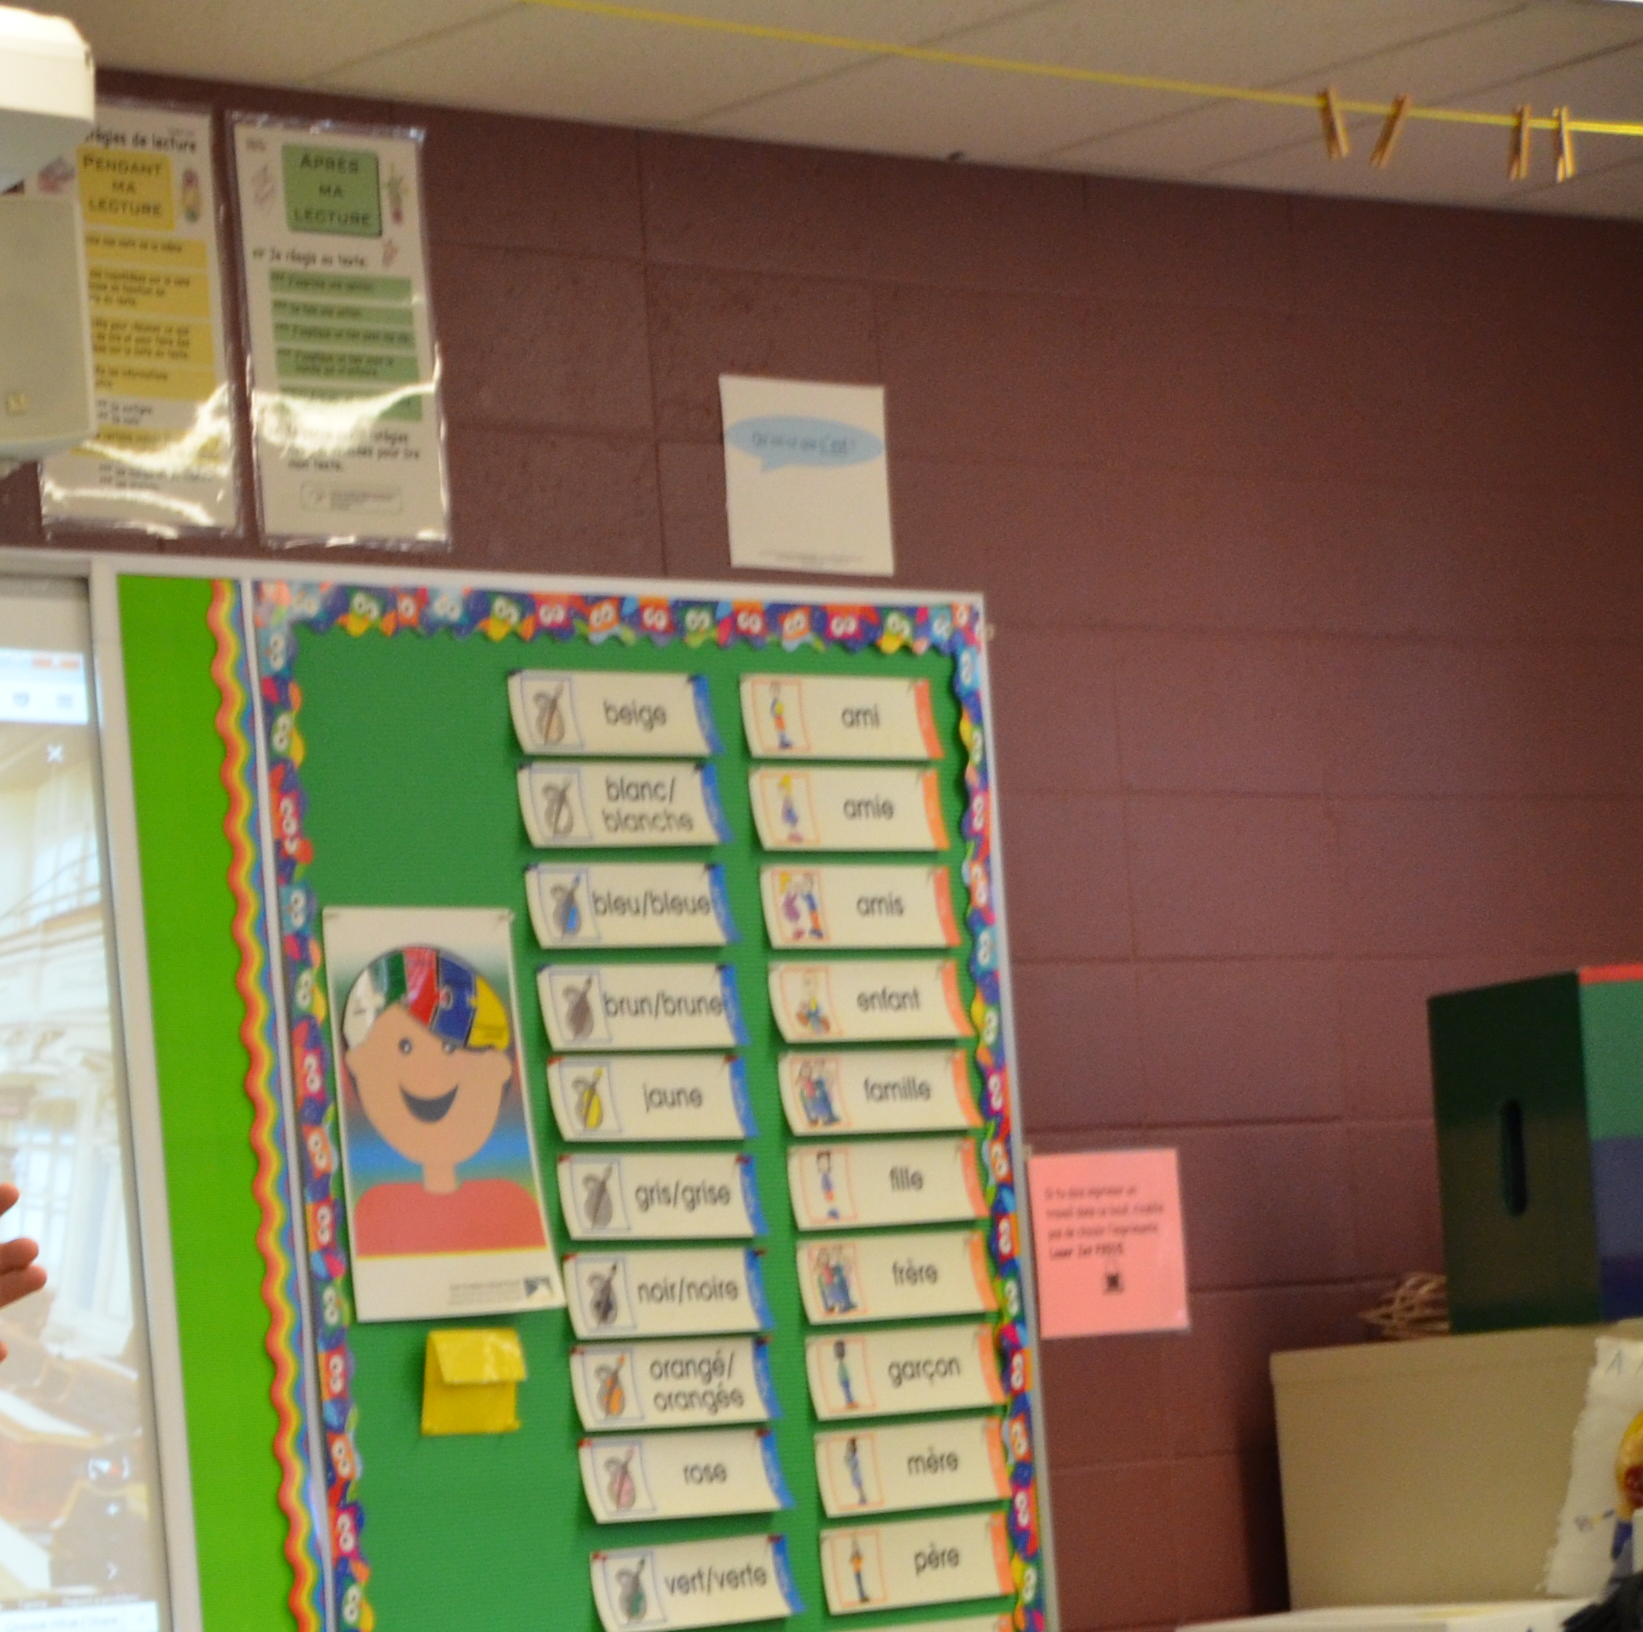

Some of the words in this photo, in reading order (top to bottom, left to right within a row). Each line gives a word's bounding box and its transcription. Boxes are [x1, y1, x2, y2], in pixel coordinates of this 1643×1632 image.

[83, 152, 164, 177] PENDANT
[604, 700, 668, 732] beige
[841, 705, 880, 729] ami
[606, 776, 675, 803] blanc/
[602, 808, 694, 833] blanche
[843, 797, 895, 820] amie
[593, 887, 711, 917] bleu/bleue
[857, 893, 905, 917] amis
[601, 986, 722, 1018] brun/brune
[857, 987, 920, 1012] enfant
[643, 1084, 704, 1113] jaune
[864, 1076, 932, 1102] famille
[890, 1166, 924, 1191] fille
[635, 1180, 732, 1213] gris/grise
[892, 1259, 939, 1286] frère
[637, 1277, 740, 1304] noir/noire
[648, 1350, 736, 1384] orangé/
[887, 1356, 962, 1388] garçon
[653, 1381, 745, 1415] orangée
[682, 1462, 728, 1485] rose
[906, 1447, 960, 1474] mère
[913, 1543, 961, 1576] père
[665, 1562, 768, 1595] vert/verte
